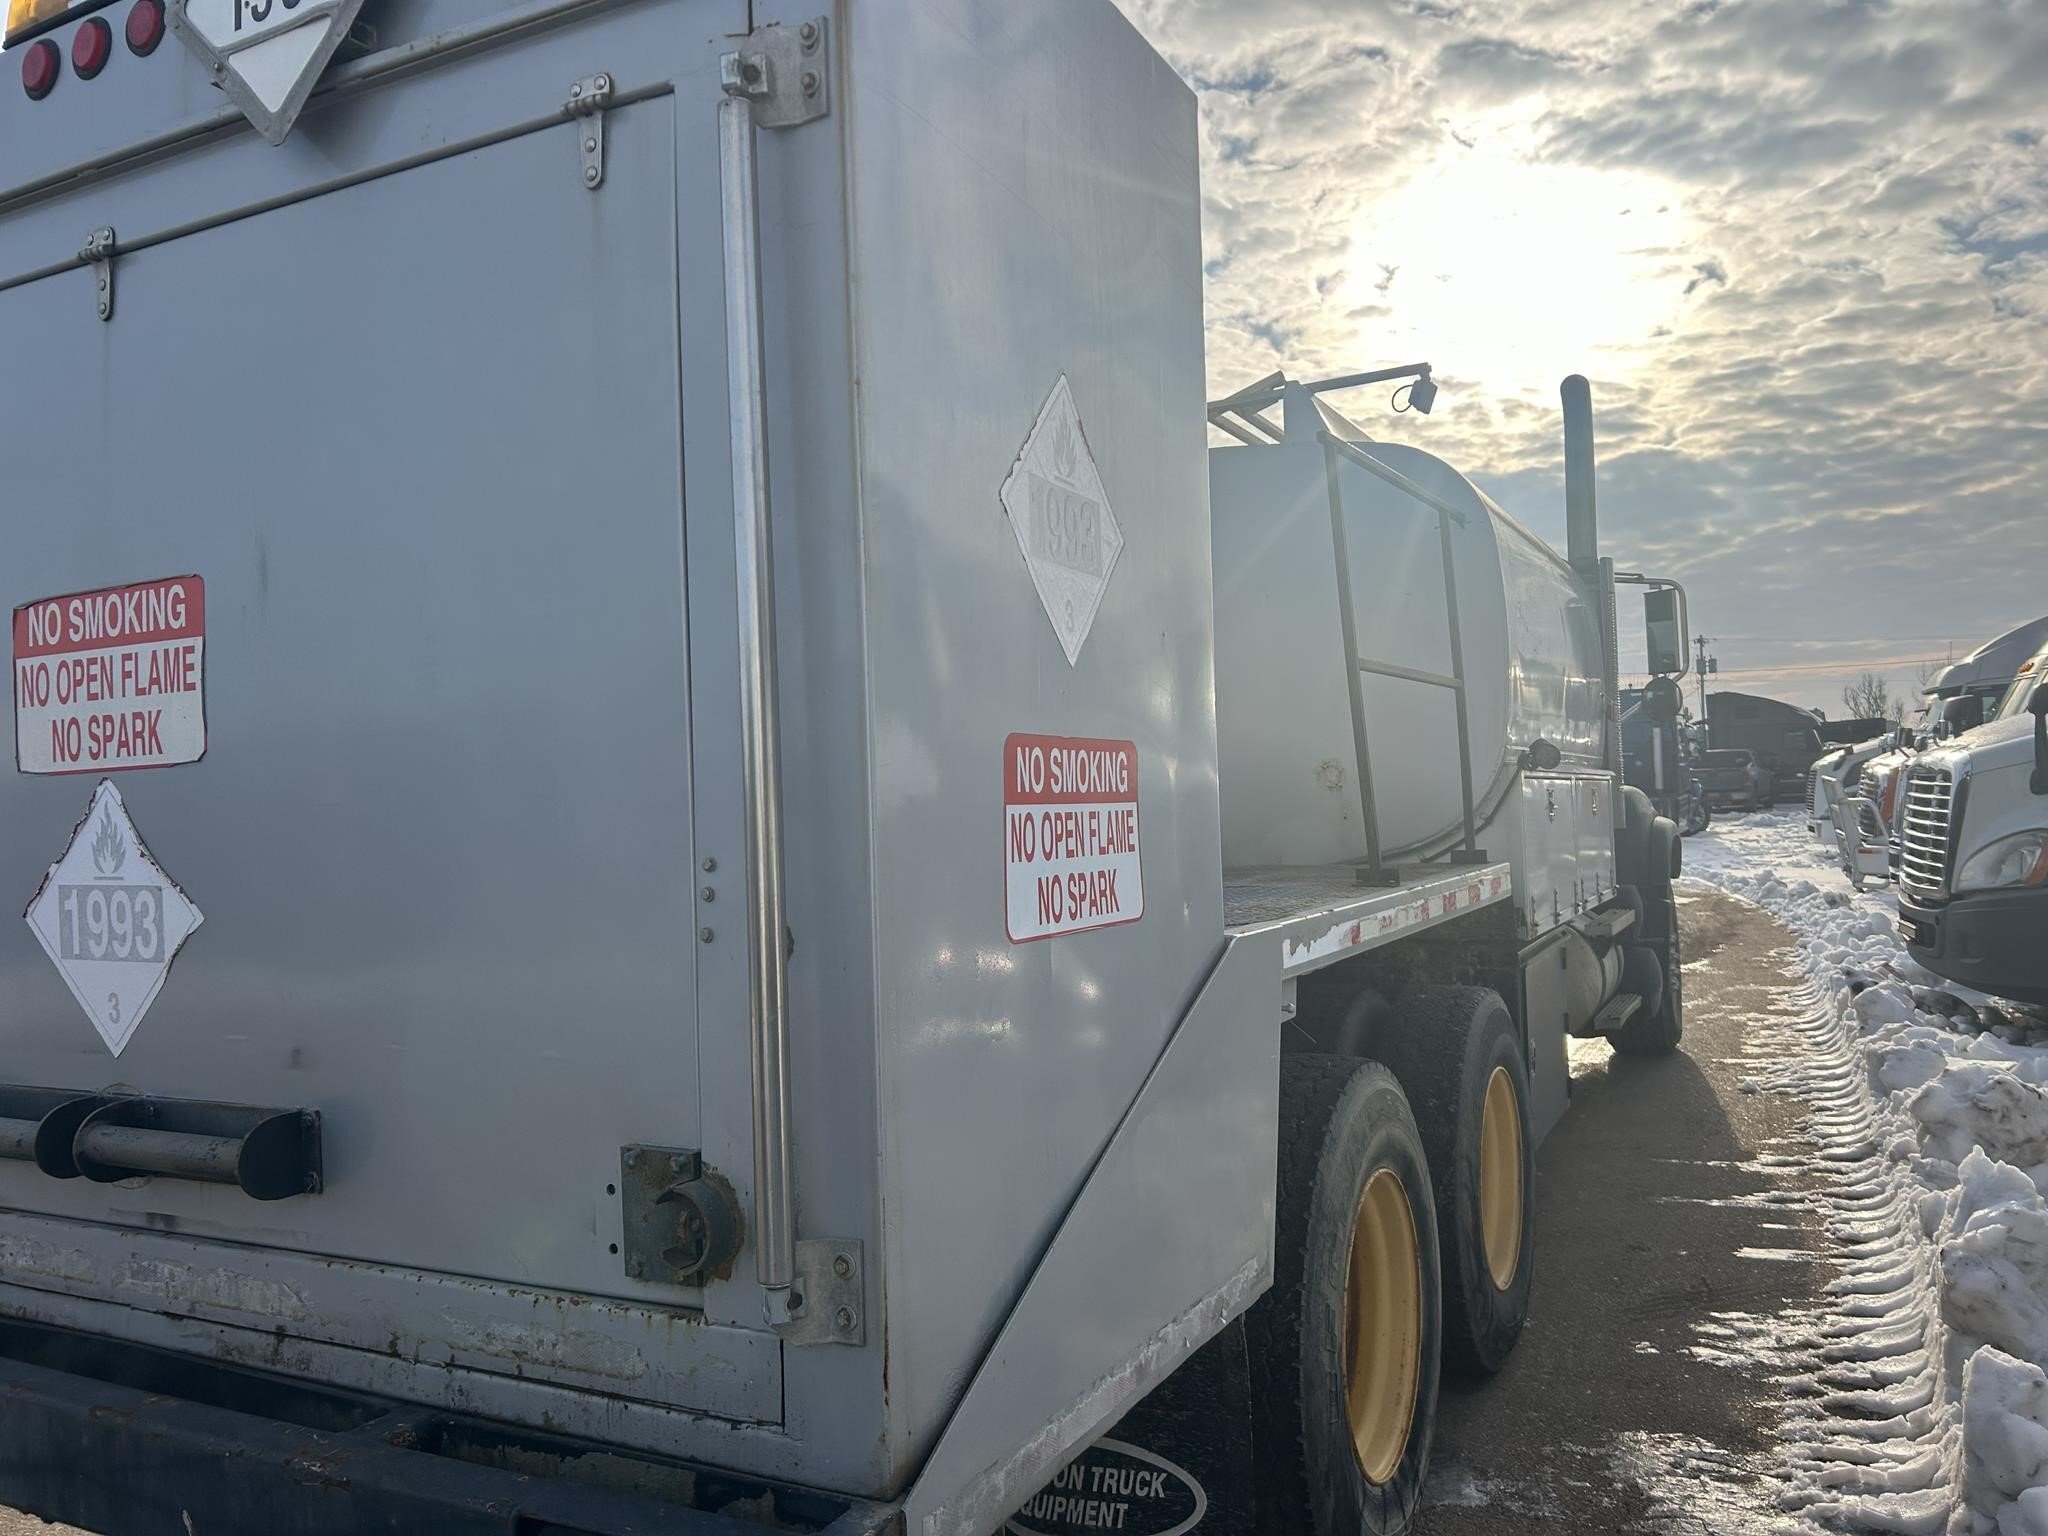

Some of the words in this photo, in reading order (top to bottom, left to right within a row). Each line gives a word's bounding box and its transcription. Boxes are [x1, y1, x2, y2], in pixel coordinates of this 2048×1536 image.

[28, 602, 62, 647] NO
[69, 584, 186, 642] SMOKING
[1064, 599, 1075, 632] 3
[22, 662, 50, 708] NO
[56, 655, 114, 705] OPEN
[121, 645, 197, 698] FLAME
[52, 716, 82, 763] NO
[88, 709, 163, 761] SPARK
[1016, 746, 1045, 794] NO
[1050, 747, 1128, 794] SMOKING
[1010, 811, 1036, 863] NO
[1041, 811, 1085, 862] OPEN
[1088, 809, 1136, 857] FLAME
[64, 889, 158, 959] 1993
[1037, 874, 1063, 926] NO
[1067, 868, 1120, 921] SPARK
[108, 992, 121, 1024] 3
[1091, 1466, 1168, 1498] TRUCK
